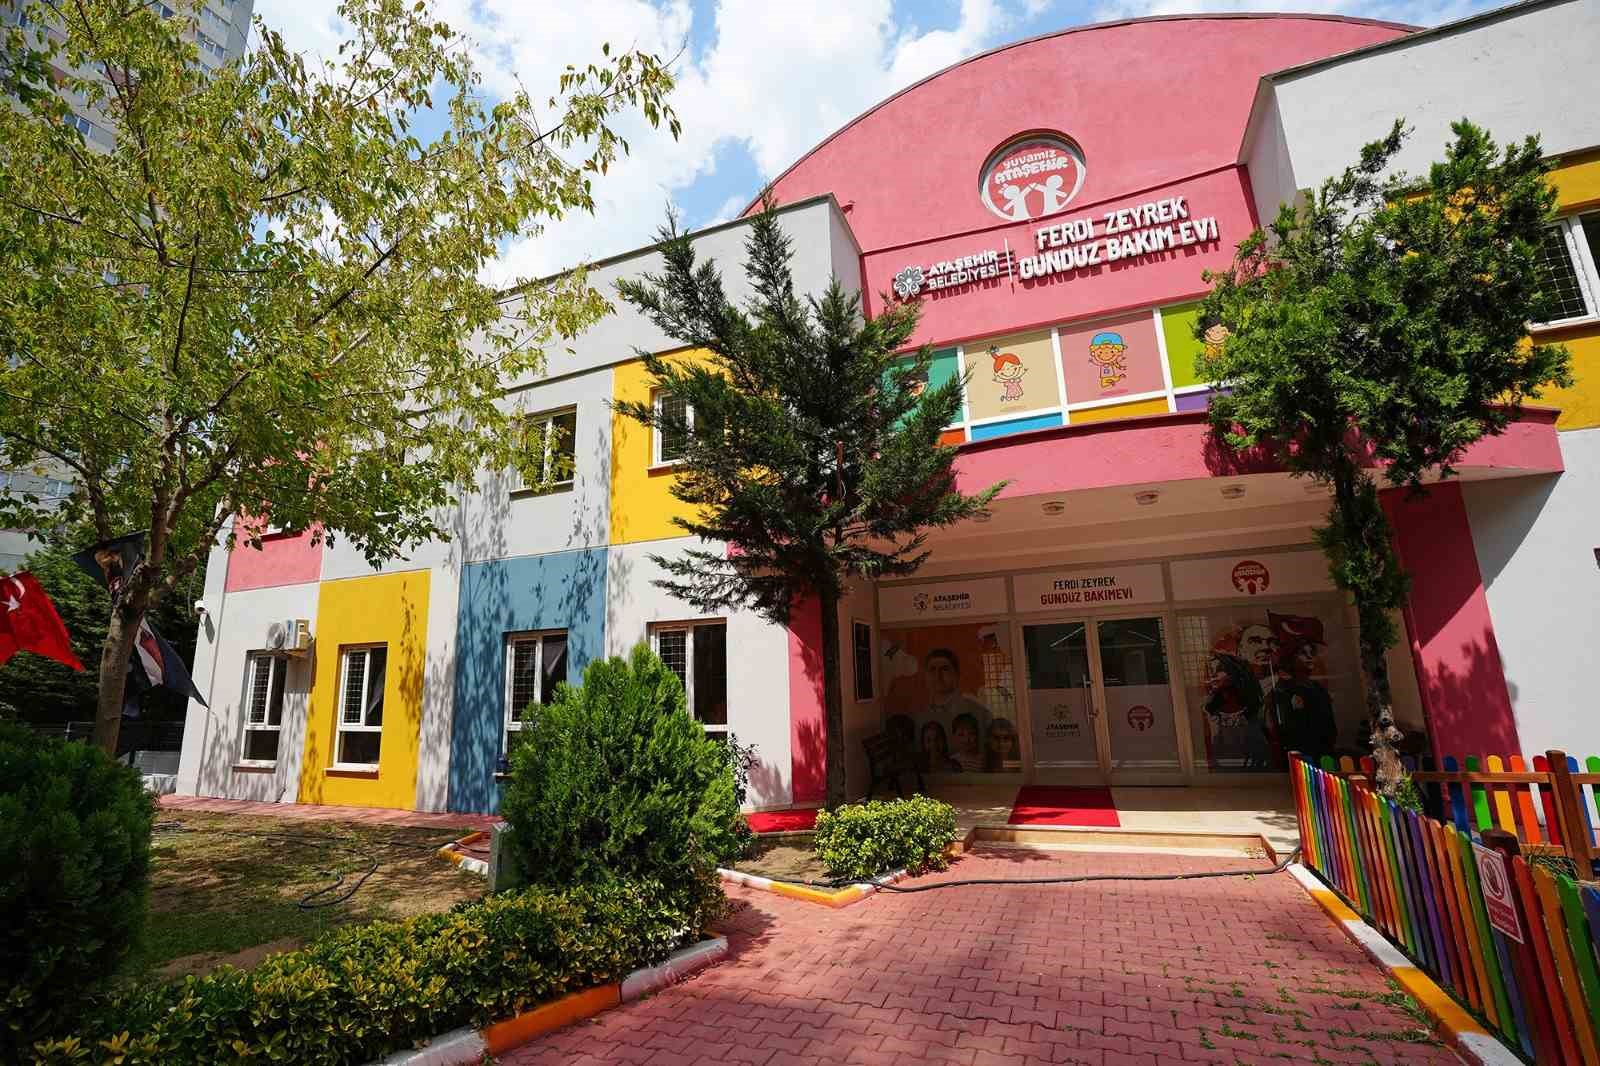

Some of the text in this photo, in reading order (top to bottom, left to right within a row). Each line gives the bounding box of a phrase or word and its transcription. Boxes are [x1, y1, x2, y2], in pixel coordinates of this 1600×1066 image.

[1104, 196, 1188, 234] ZEYREK
[1106, 226, 1176, 262] BAKIM
[1080, 576, 1117, 588] ZEYREK
